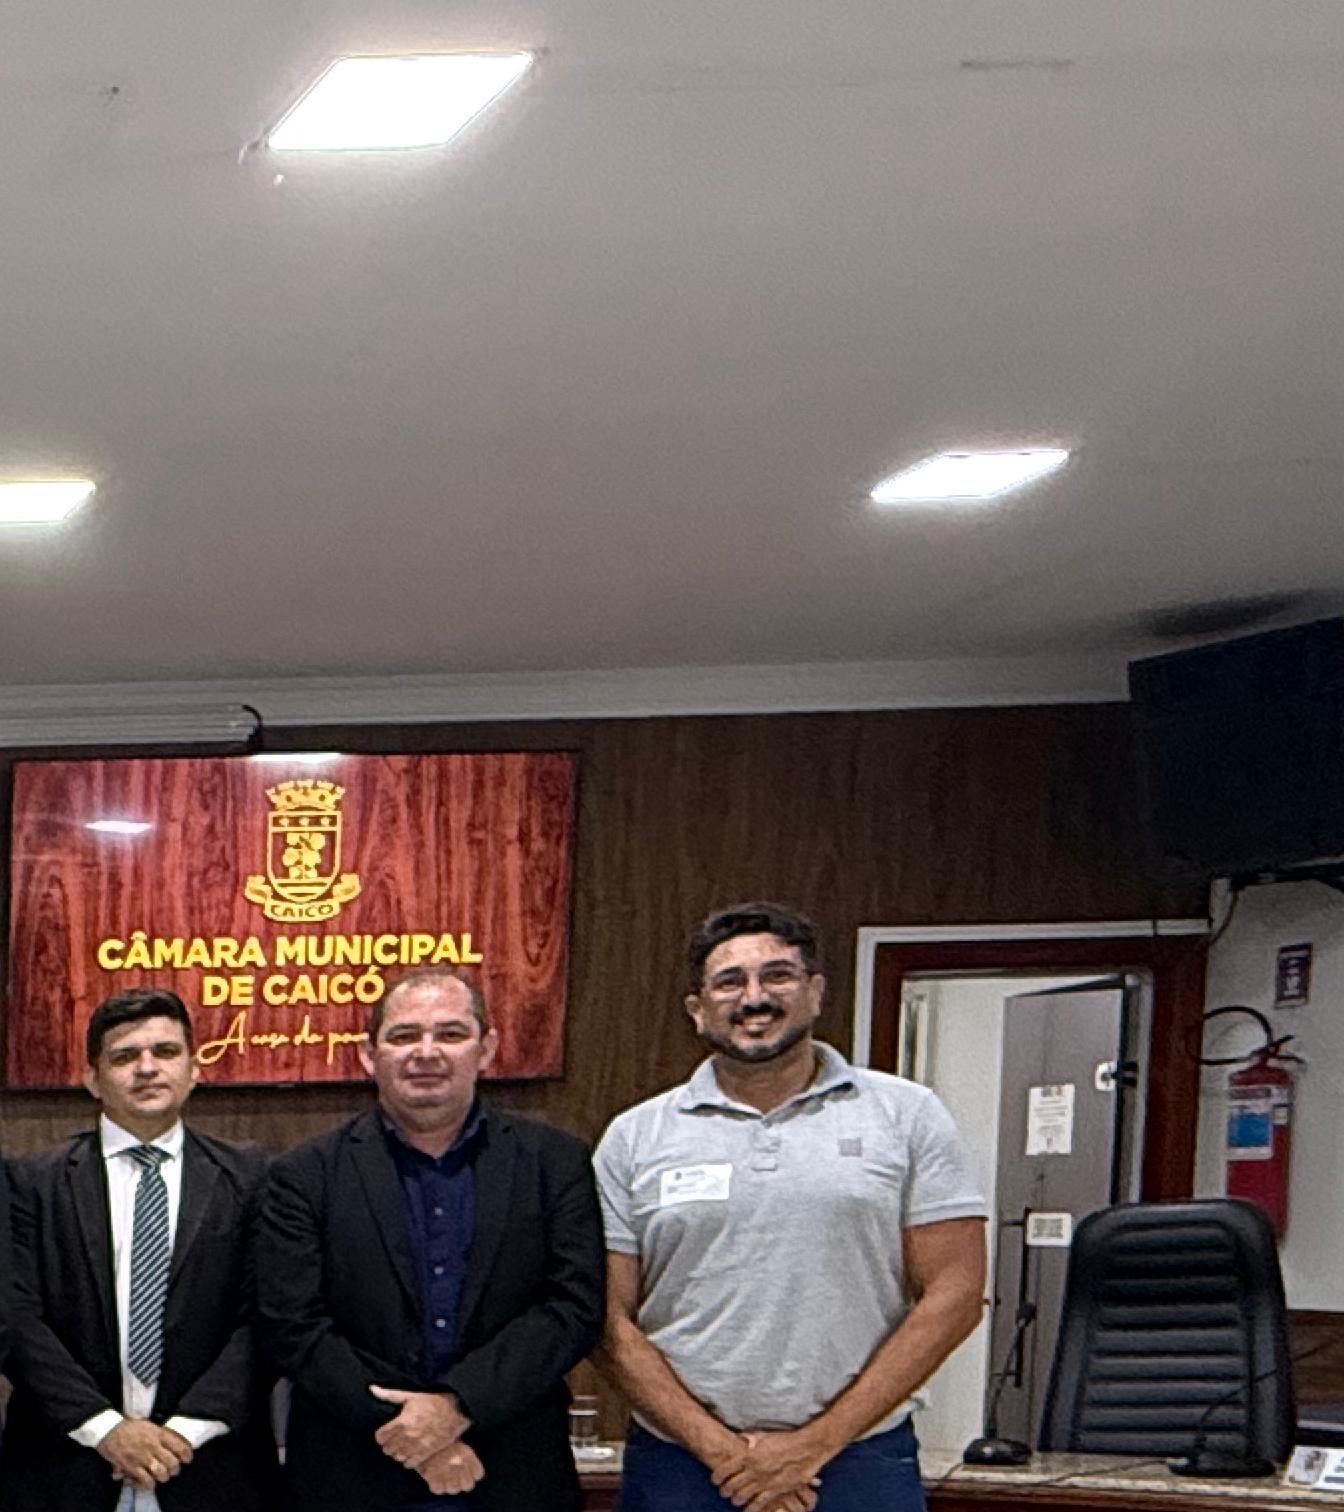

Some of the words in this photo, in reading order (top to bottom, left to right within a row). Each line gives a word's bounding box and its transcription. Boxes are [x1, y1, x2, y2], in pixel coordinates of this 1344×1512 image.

[97, 931, 264, 970] CÂMARA
[276, 933, 483, 967] MUNICIPAL
[203, 976, 254, 1006] DE
[263, 966, 385, 1005] CAICÓ
[196, 1010, 246, 1065] A
